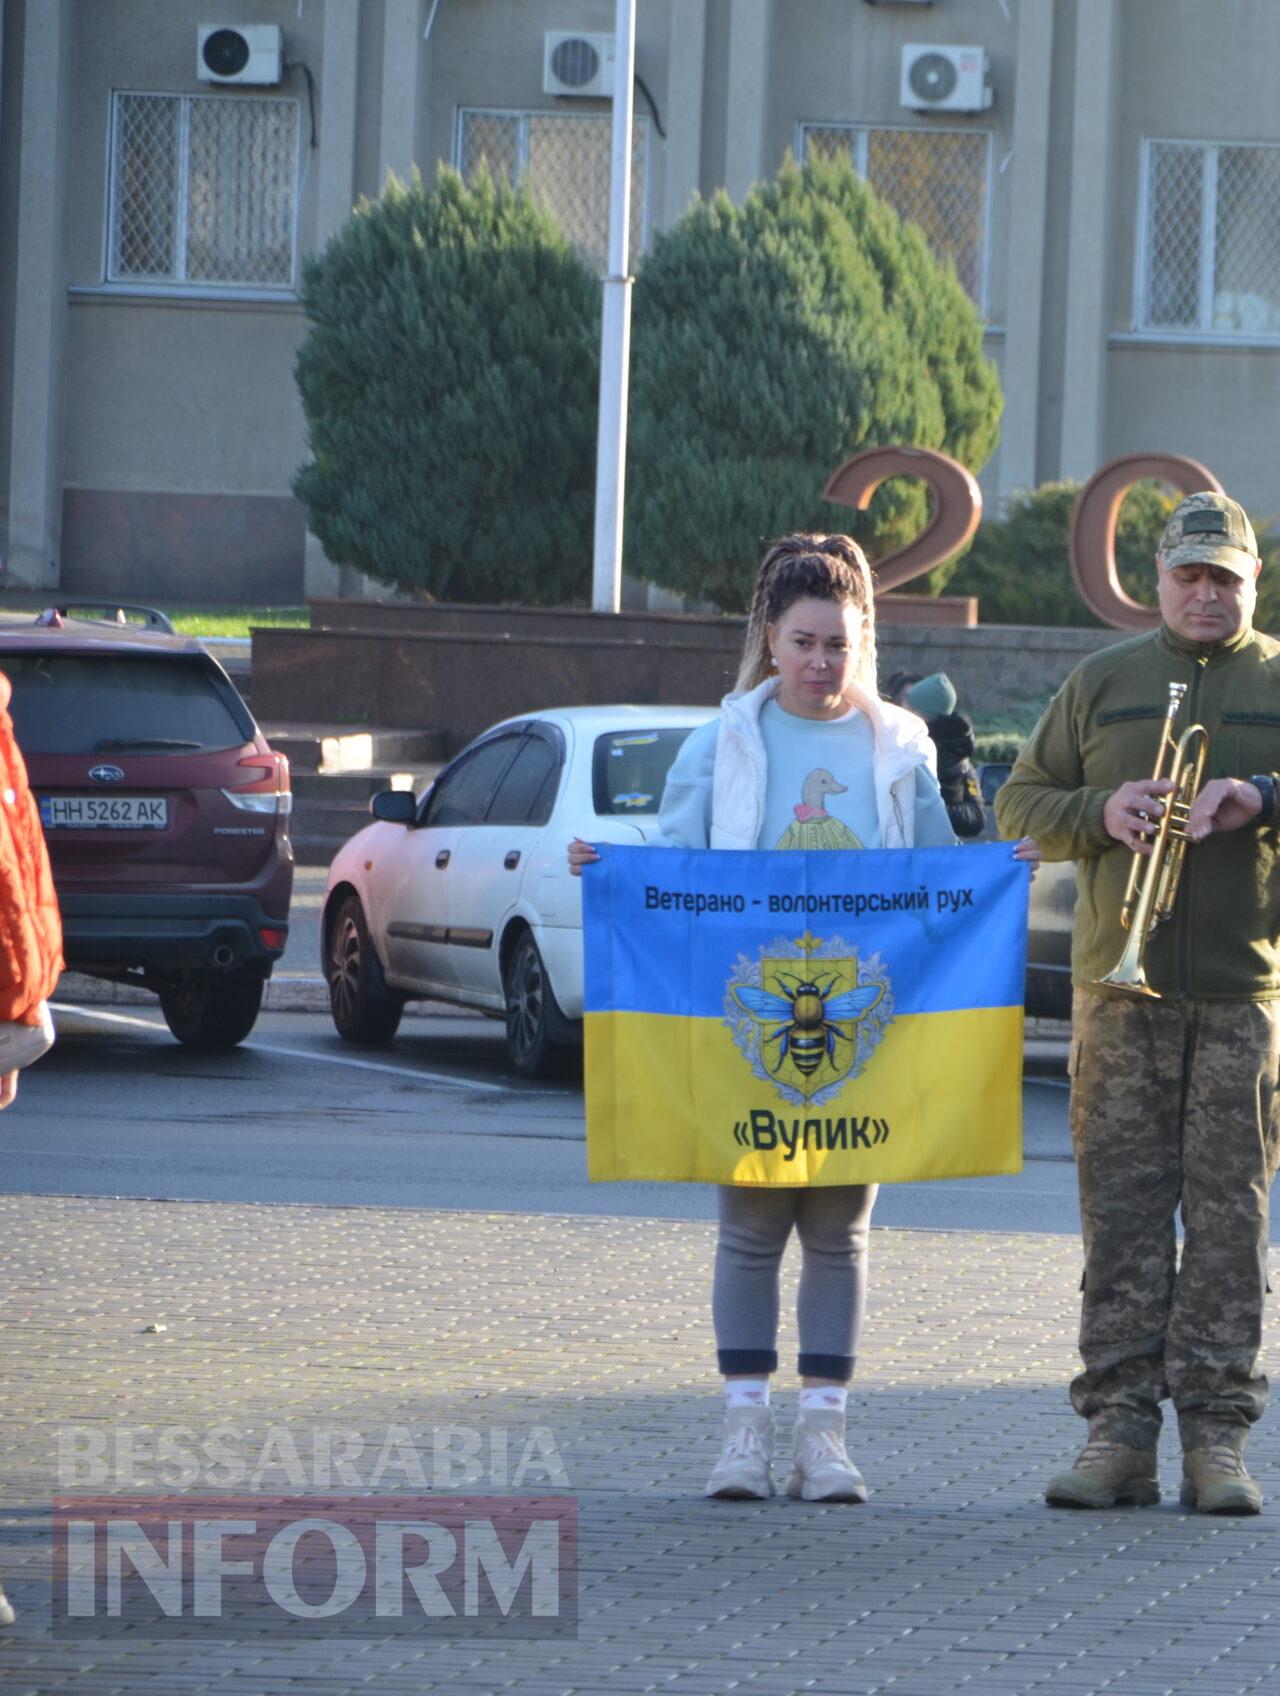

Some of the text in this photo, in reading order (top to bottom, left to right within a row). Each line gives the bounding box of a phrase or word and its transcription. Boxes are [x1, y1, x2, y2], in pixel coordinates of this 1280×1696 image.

[53, 801, 164, 820] HH 5262 AK
[213, 827, 265, 835] FORESTER
[644, 886, 745, 916] Ветерано
[769, 886, 929, 917] волонтерський
[937, 887, 974, 914] рух
[733, 1109, 890, 1162] «Вулик»
